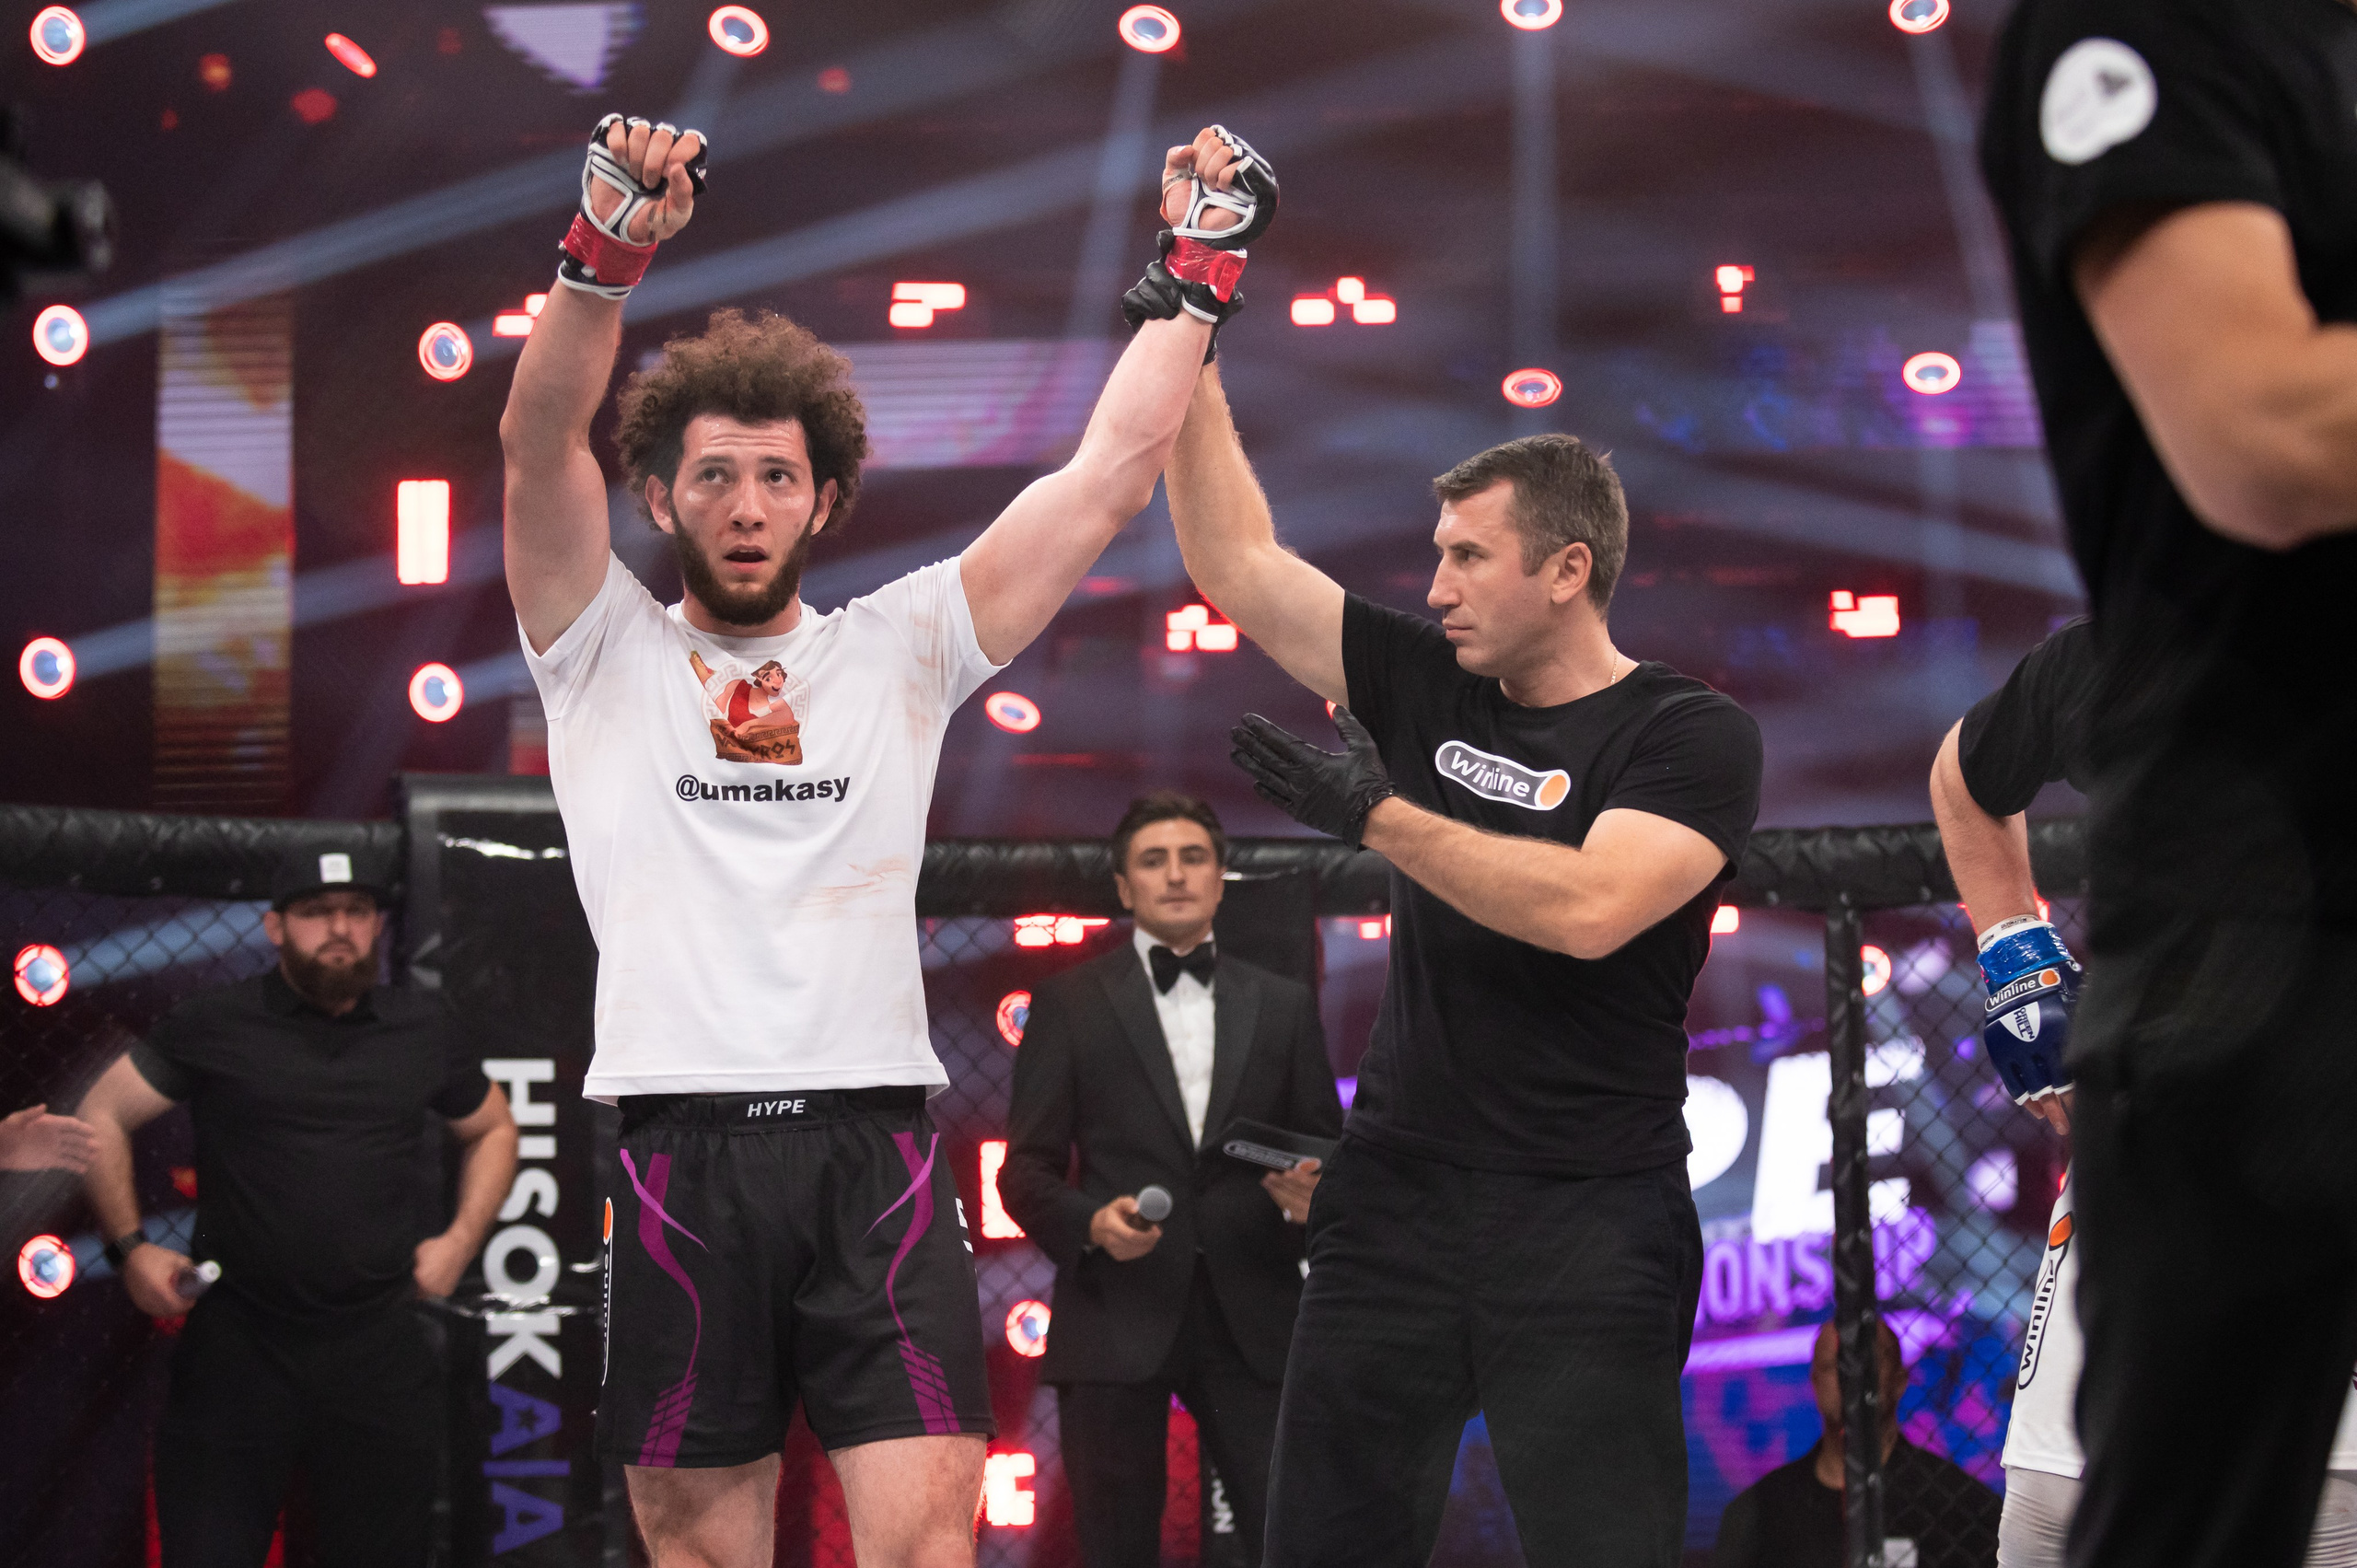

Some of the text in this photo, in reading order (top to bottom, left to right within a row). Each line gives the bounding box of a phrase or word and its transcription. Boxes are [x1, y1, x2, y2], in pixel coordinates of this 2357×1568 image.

[676, 774, 851, 803] @umakasy
[1989, 980, 2037, 1006] Winline
[746, 1098, 807, 1118] HYPE
